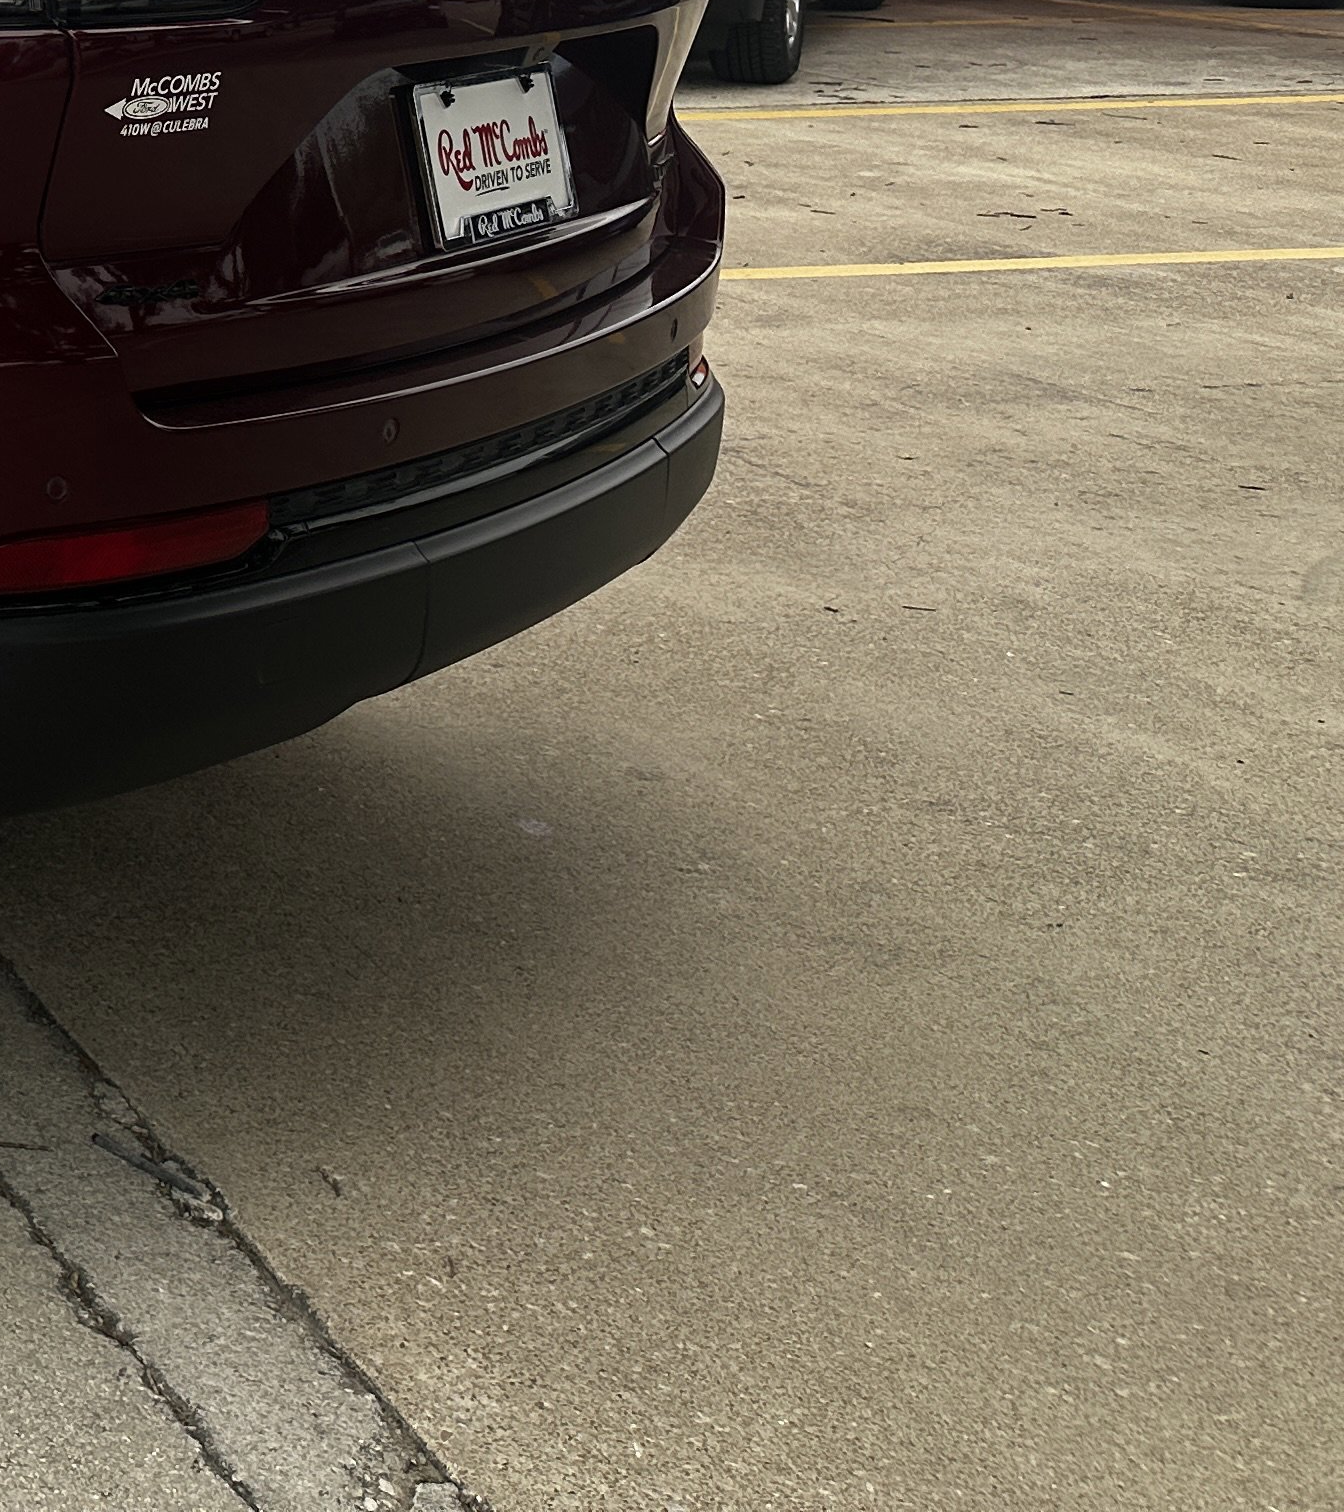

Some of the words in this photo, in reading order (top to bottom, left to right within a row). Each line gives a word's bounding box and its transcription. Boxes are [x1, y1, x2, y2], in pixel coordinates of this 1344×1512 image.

[131, 72, 221, 96] McCOMBS
[133, 102, 160, 114] Ford
[172, 92, 219, 112] WEST
[438, 129, 475, 191] Red
[471, 116, 548, 168] McCombs
[475, 171, 509, 191] DRIVEN
[510, 165, 523, 181] TO
[525, 159, 551, 179] SERVE
[478, 215, 498, 237] Red
[498, 204, 544, 229] McCombs
